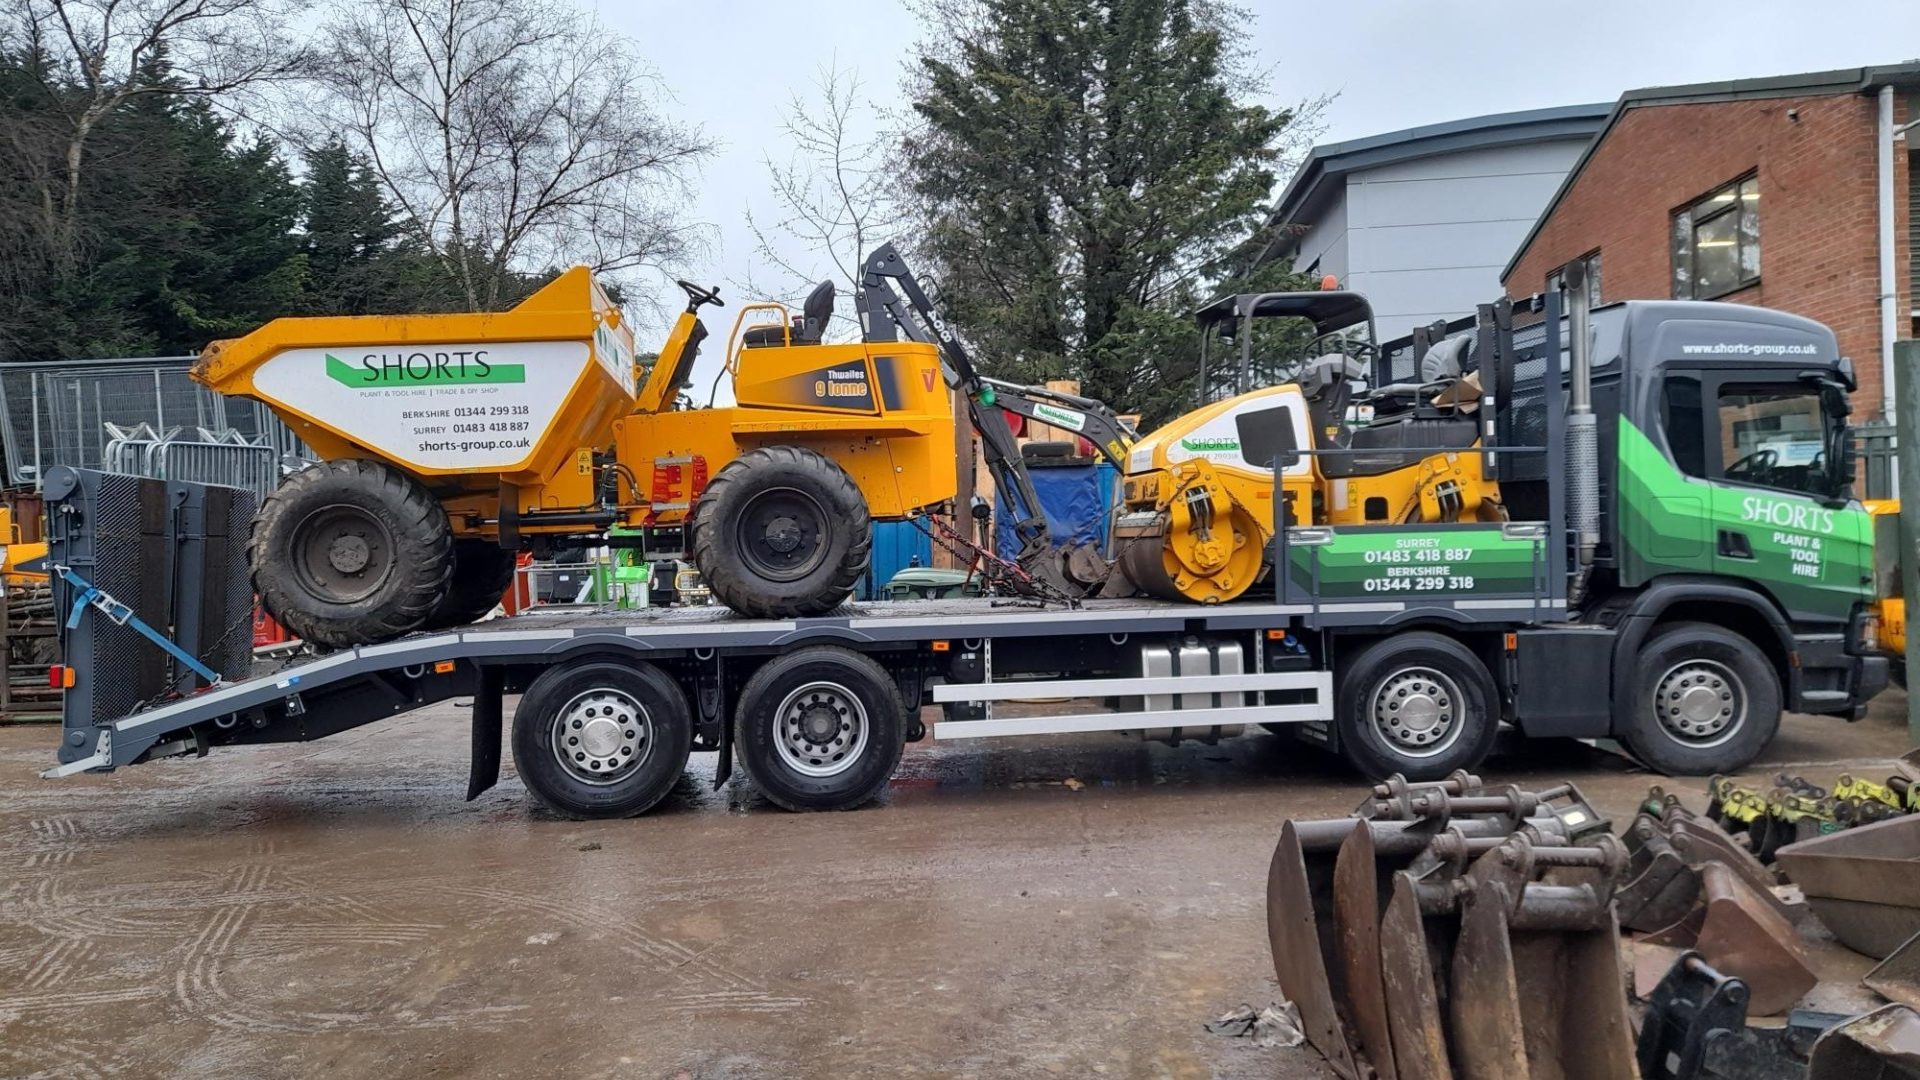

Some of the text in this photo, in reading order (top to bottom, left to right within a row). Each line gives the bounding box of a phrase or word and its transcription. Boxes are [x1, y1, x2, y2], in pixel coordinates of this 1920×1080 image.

[1682, 343, 1817, 355] www.shorts-group.co.uk
[362, 351, 491, 382] SHORTS
[815, 381, 867, 397] 9 tonne
[402, 405, 529, 419] BERKSHIRE 01344 299 318
[413, 422, 529, 435] SURREY 01483 418 887
[419, 437, 530, 452] shorts-group.co.uk
[1191, 438, 1238, 450] SHORTS
[1741, 497, 1834, 533] SHORTS
[1396, 538, 1441, 548] SURREY
[1773, 532, 1821, 549] PLANT &
[1364, 548, 1473, 563] 01483 418 887
[1790, 549, 1820, 563] TOOL
[1387, 566, 1451, 577] BERKSHIRE
[1792, 563, 1819, 577] HIRE
[1364, 576, 1474, 591] 01344 299 318
